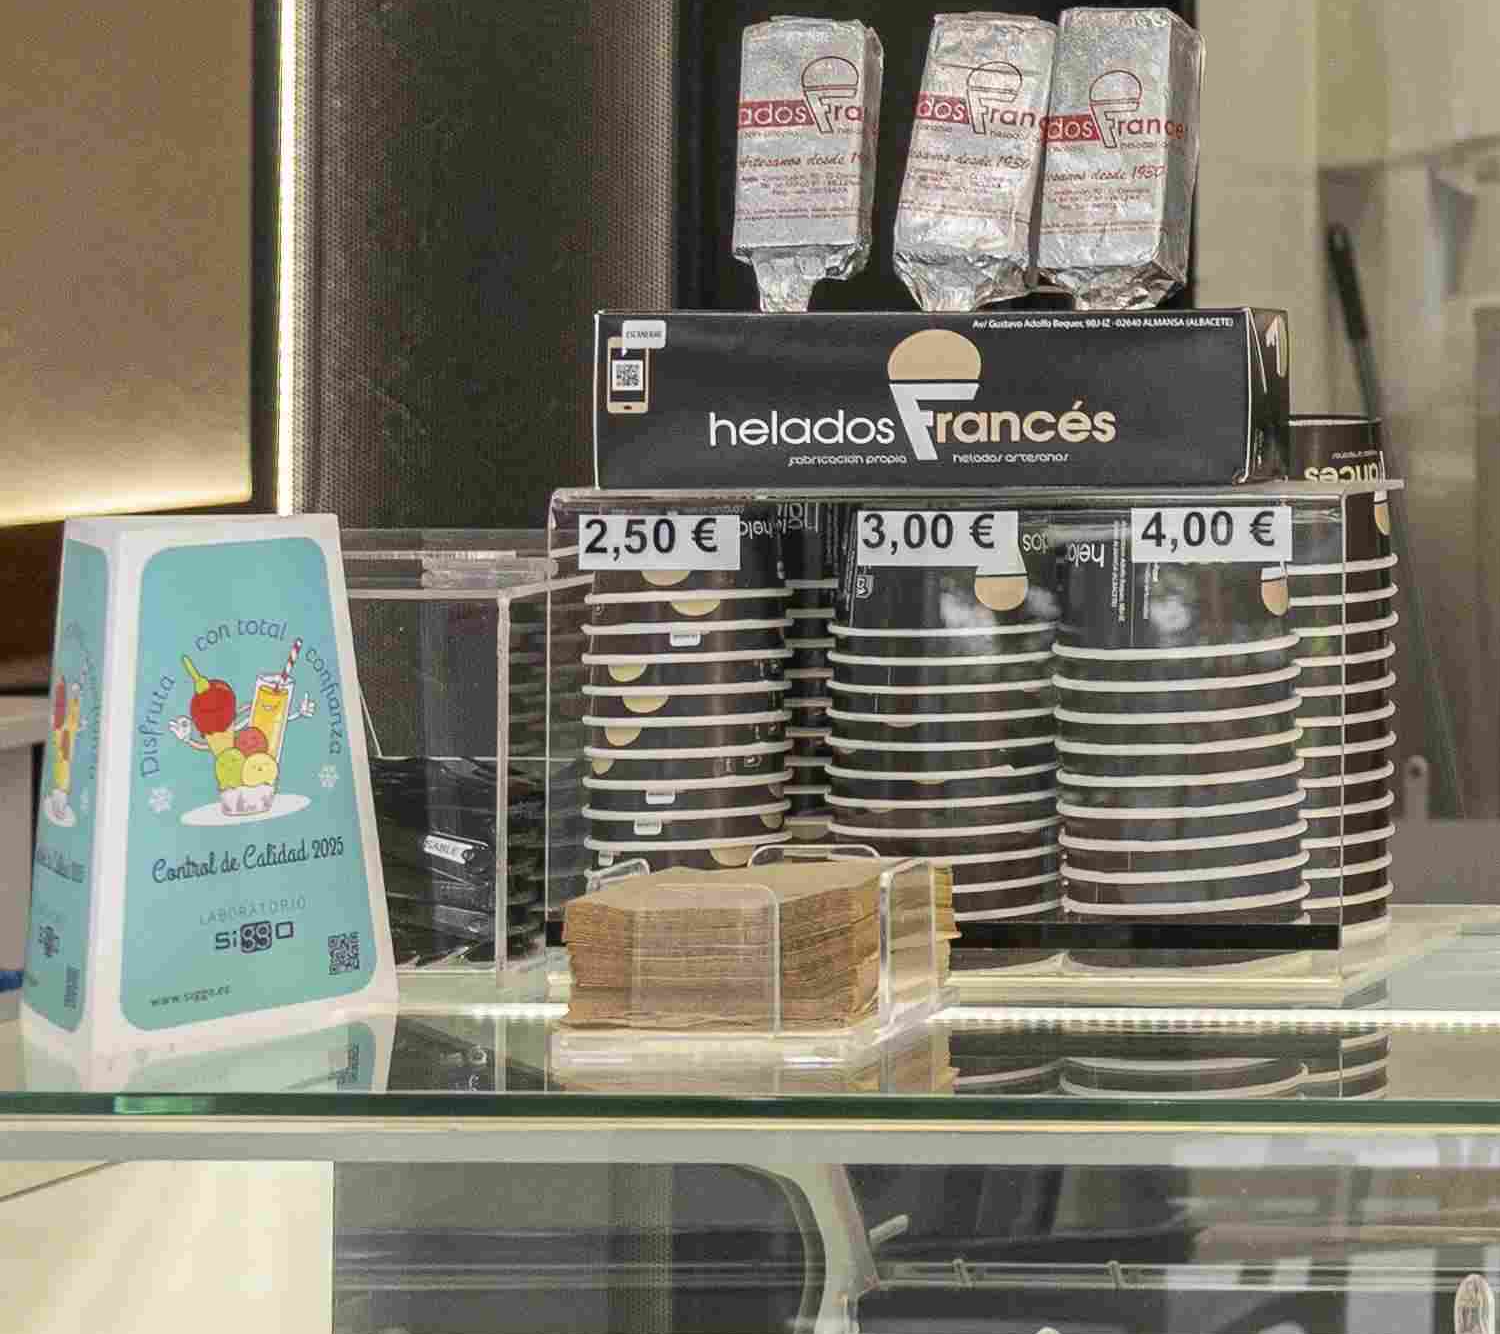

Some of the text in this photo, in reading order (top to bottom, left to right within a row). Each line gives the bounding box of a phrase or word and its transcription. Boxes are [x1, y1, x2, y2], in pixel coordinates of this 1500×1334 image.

[739, 101, 807, 126] ados
[708, 409, 897, 447] helados
[584, 517, 719, 561] 2,50 €
[862, 513, 954, 555] 3,00
[969, 513, 996, 549] €
[1141, 510, 1276, 554] 4,00 €
[139, 618, 342, 778] Disfruta con total confianza
[151, 835, 344, 884] Control de Calidad 2025
[199, 894, 307, 925] LABORATORIO
